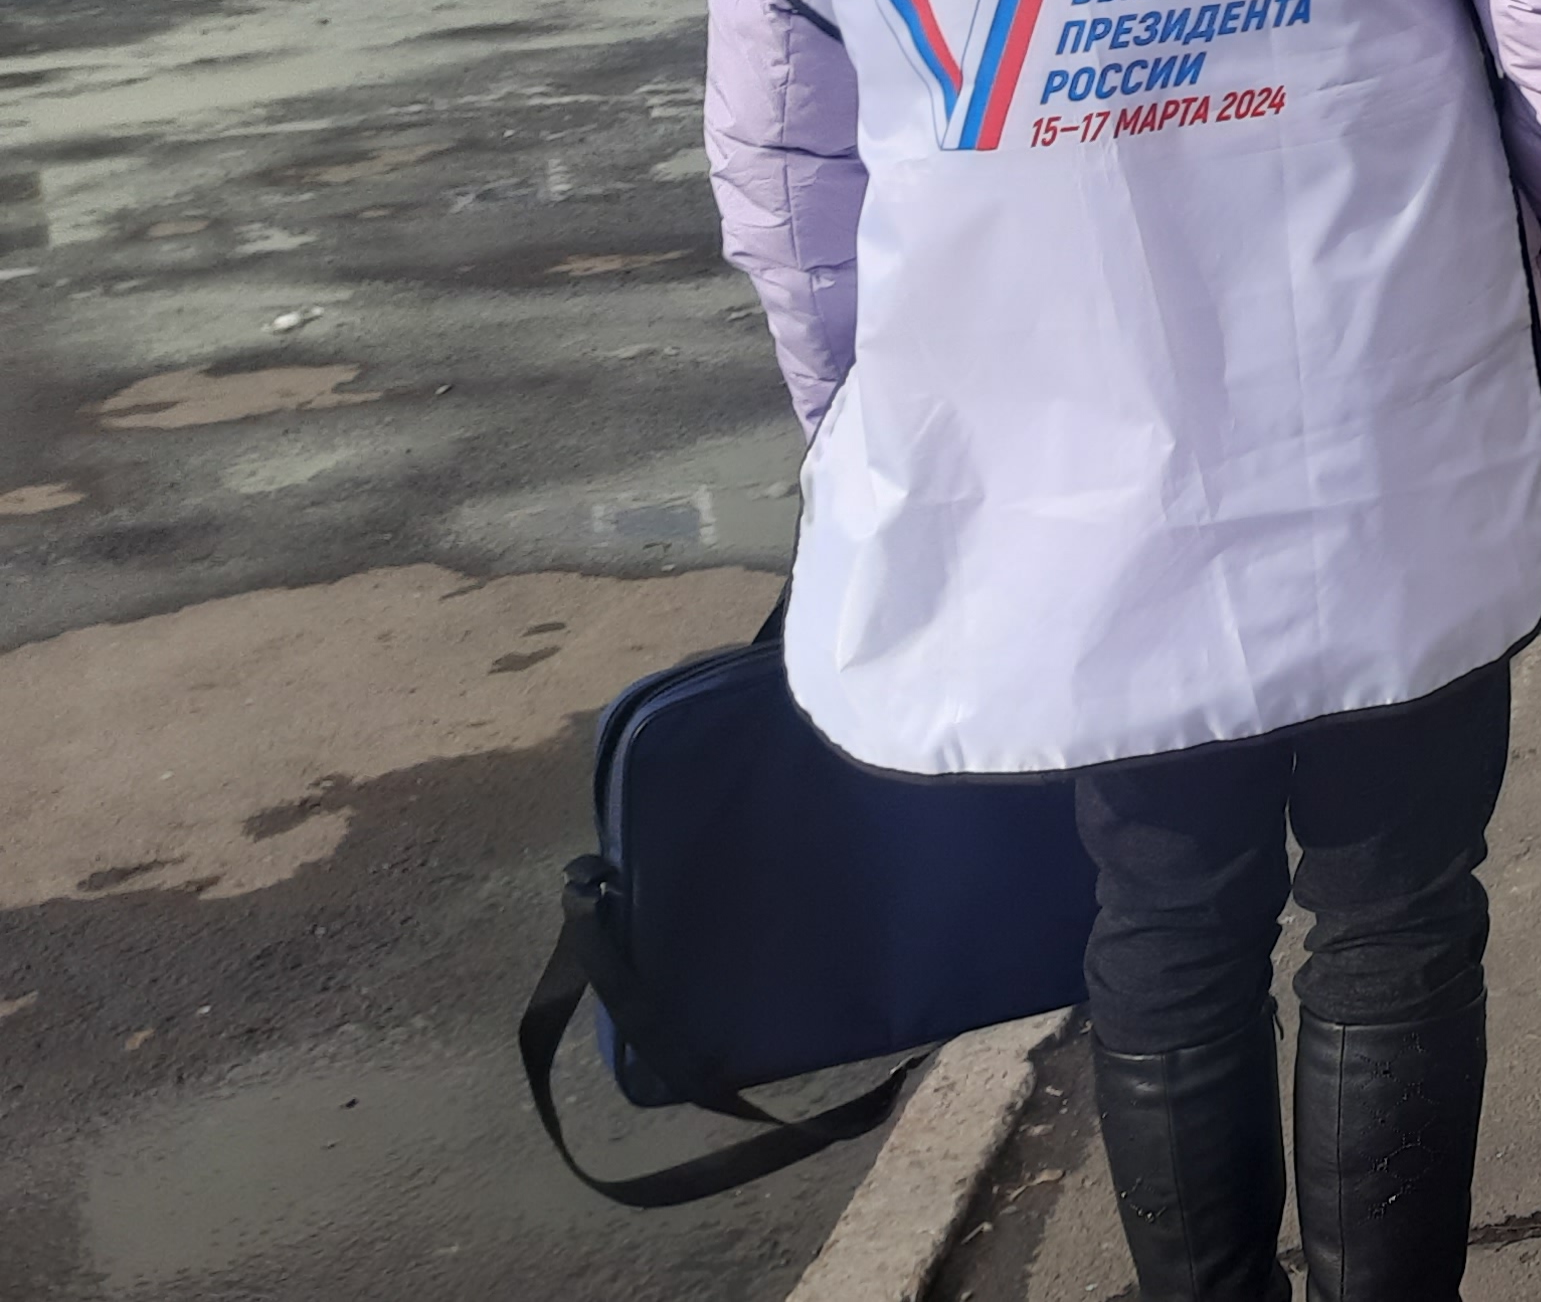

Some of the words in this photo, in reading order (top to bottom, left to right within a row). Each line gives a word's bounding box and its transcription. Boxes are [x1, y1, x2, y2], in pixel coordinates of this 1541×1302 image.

[1040, 51, 1207, 106] РОССИИ
[1113, 95, 1210, 139] МАРТА
[1215, 86, 1286, 121] 2024
